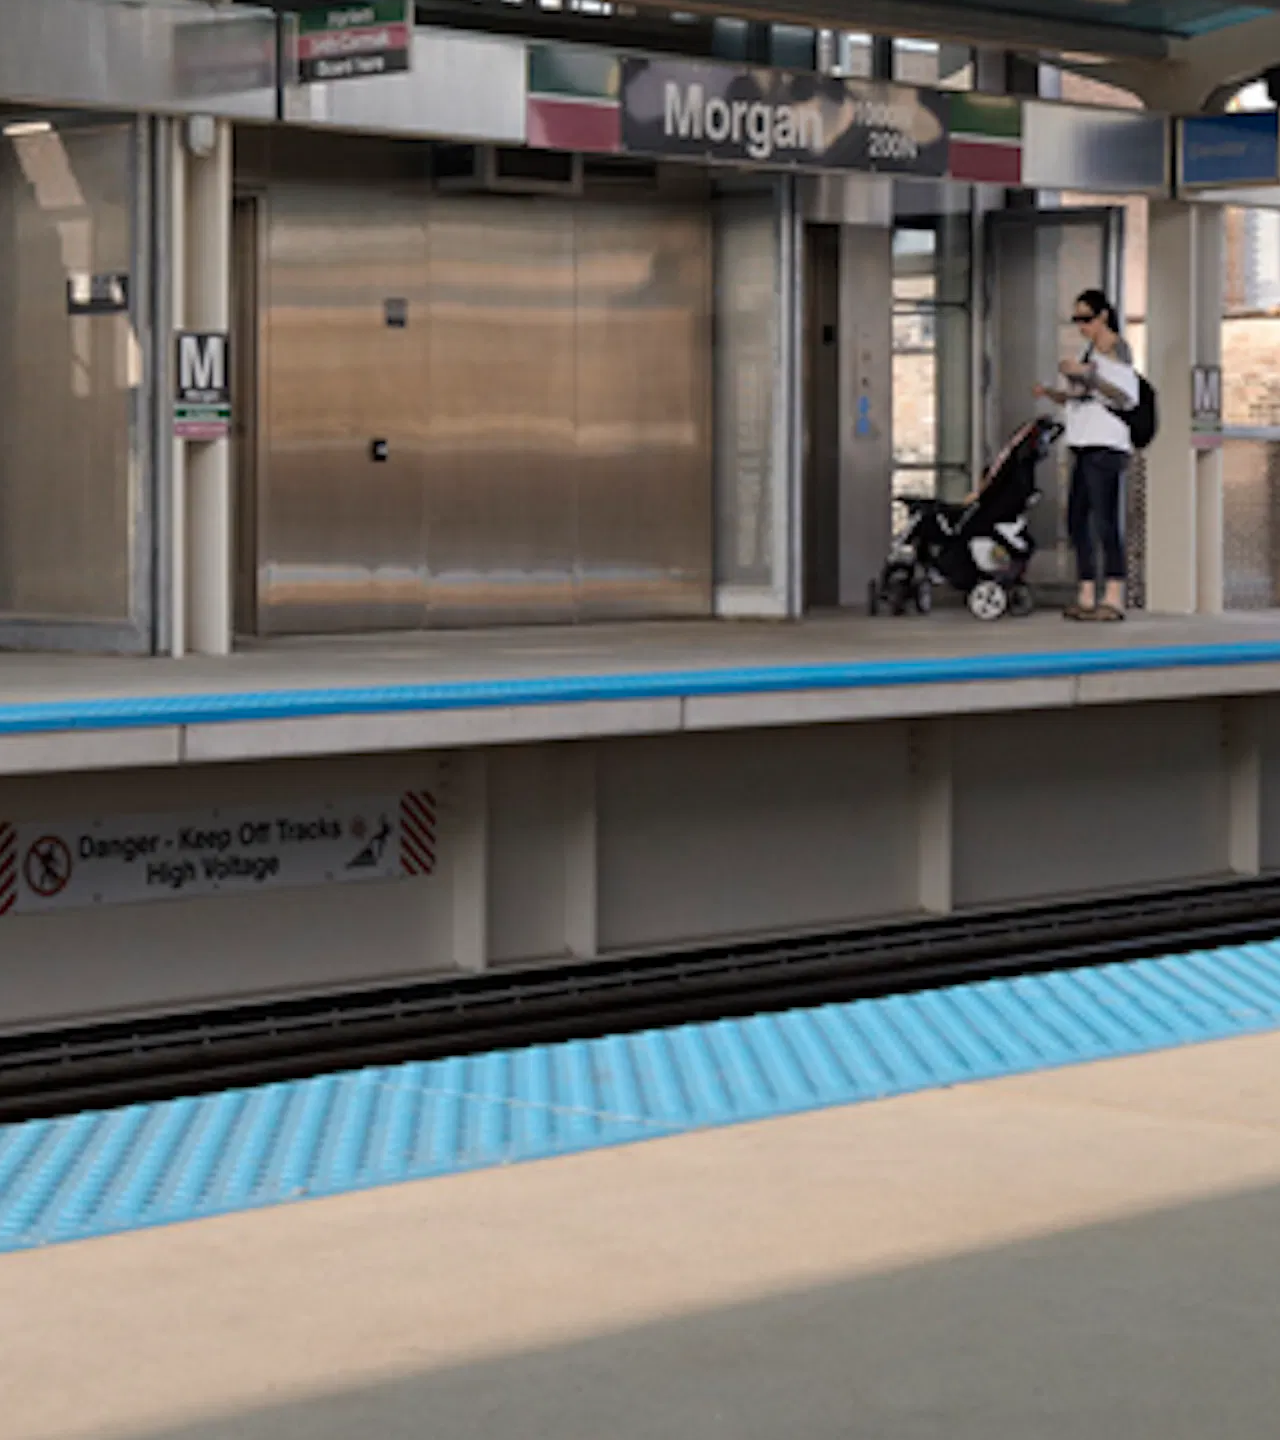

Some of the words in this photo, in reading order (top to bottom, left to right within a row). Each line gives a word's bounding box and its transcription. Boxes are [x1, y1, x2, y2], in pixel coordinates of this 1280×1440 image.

[664, 81, 826, 159] Morgan
[868, 130, 918, 159] 200N
[181, 335, 224, 389] M
[1194, 368, 1218, 411] M
[79, 834, 160, 863] Danger
[177, 826, 232, 853] Keep
[238, 820, 270, 846] Off
[275, 816, 341, 841] Tracks
[146, 861, 196, 889] High
[201, 853, 280, 883] Voltage
